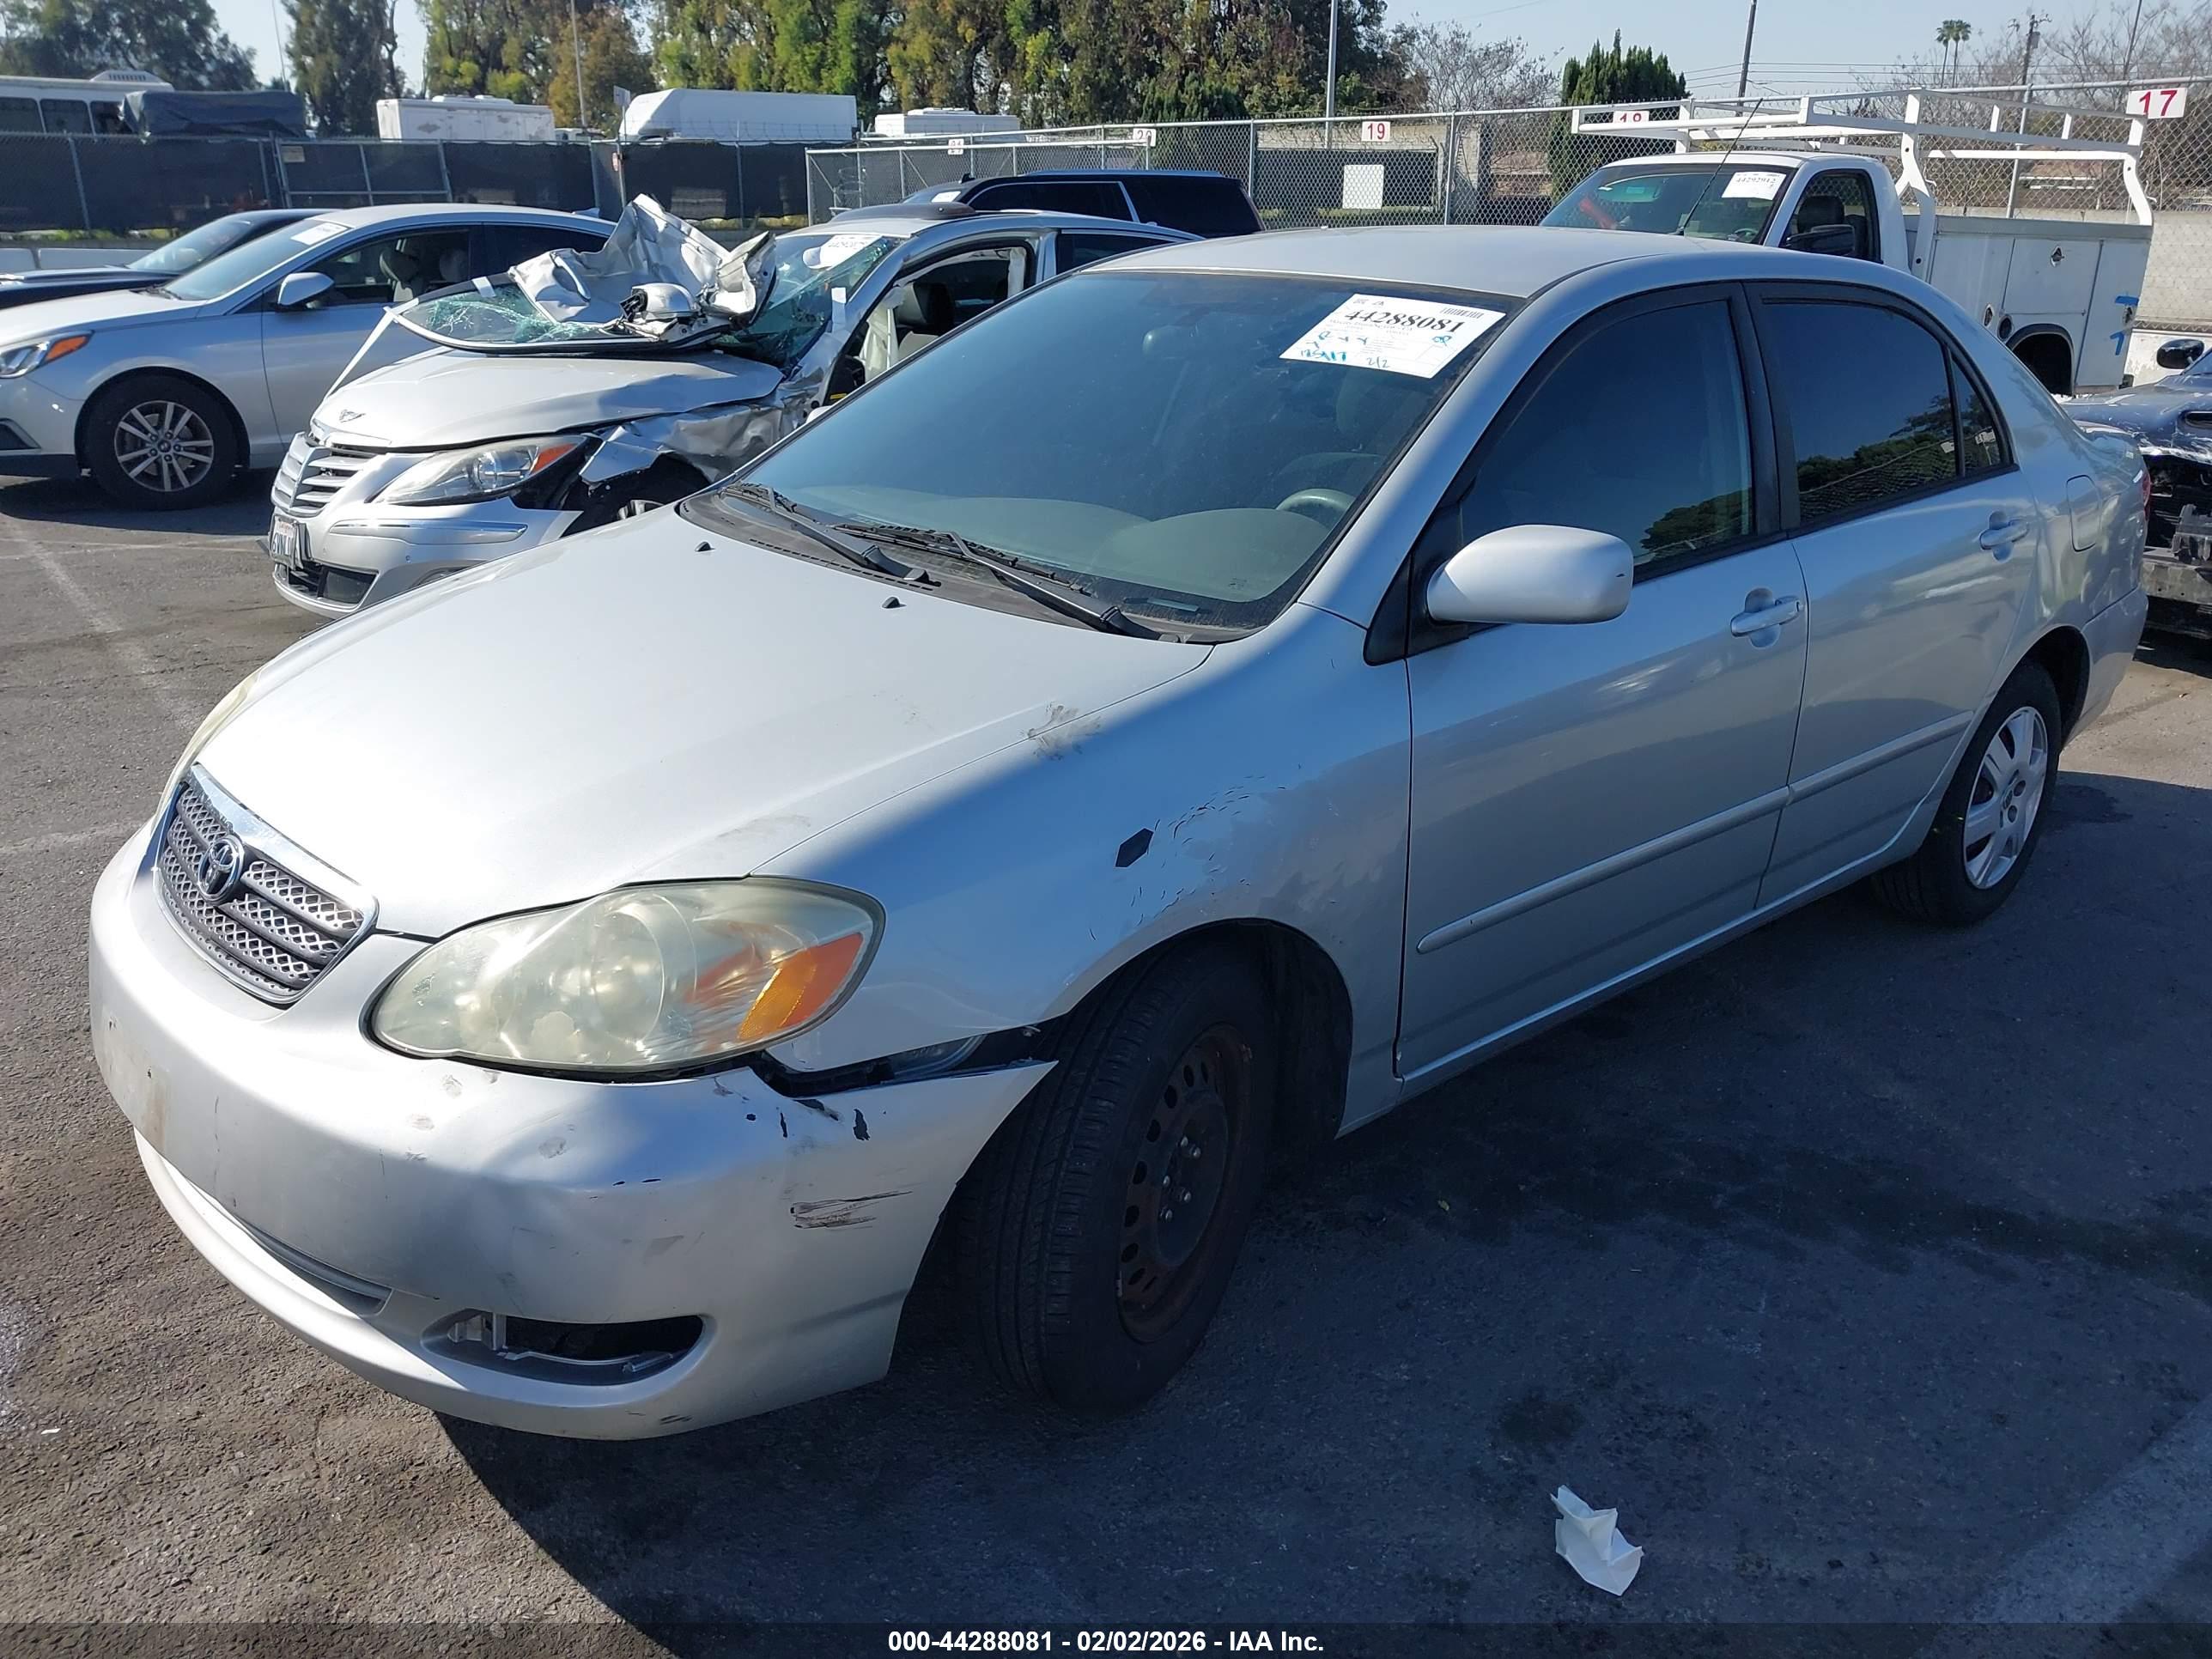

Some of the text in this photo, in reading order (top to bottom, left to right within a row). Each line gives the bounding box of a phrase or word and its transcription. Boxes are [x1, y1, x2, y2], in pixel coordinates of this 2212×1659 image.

[2139, 89, 2178, 117] 17
[1367, 123, 1385, 140] 19
[1345, 309, 1465, 332] 44288081
